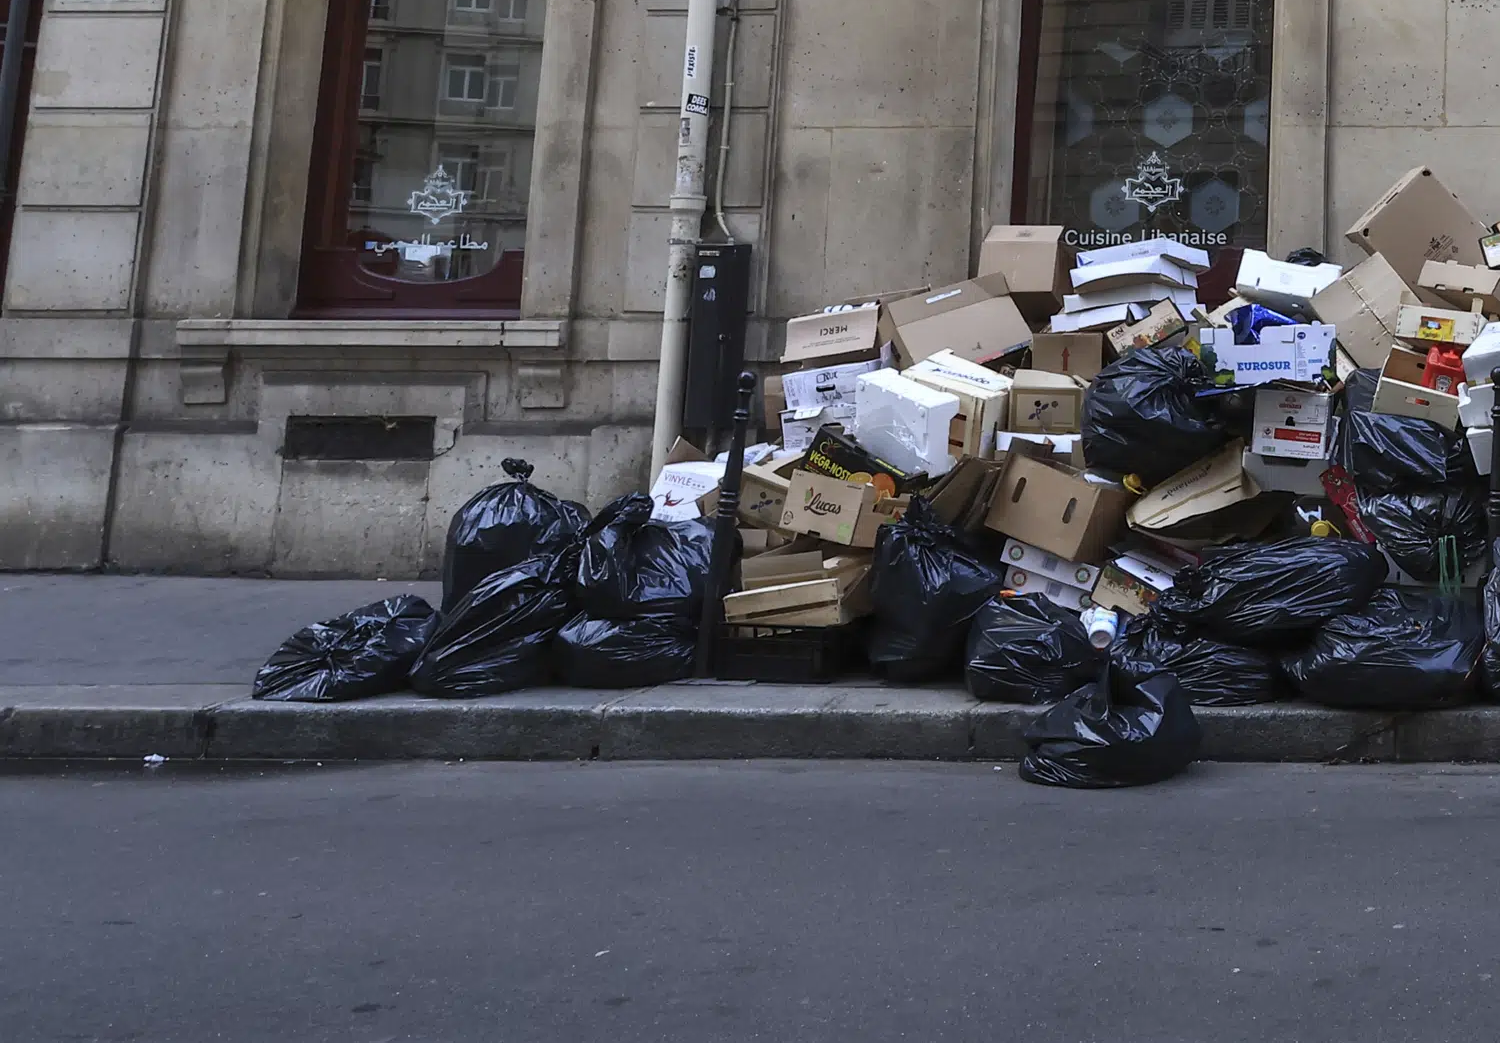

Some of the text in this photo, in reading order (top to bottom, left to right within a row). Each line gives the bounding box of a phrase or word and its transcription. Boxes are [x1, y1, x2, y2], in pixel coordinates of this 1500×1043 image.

[1065, 229, 1132, 245] Cuisine
[820, 325, 847, 337] MERCI
[1237, 361, 1291, 371] EUROSUR
[664, 472, 692, 486] VINYLE
[804, 493, 841, 516] Lucas
